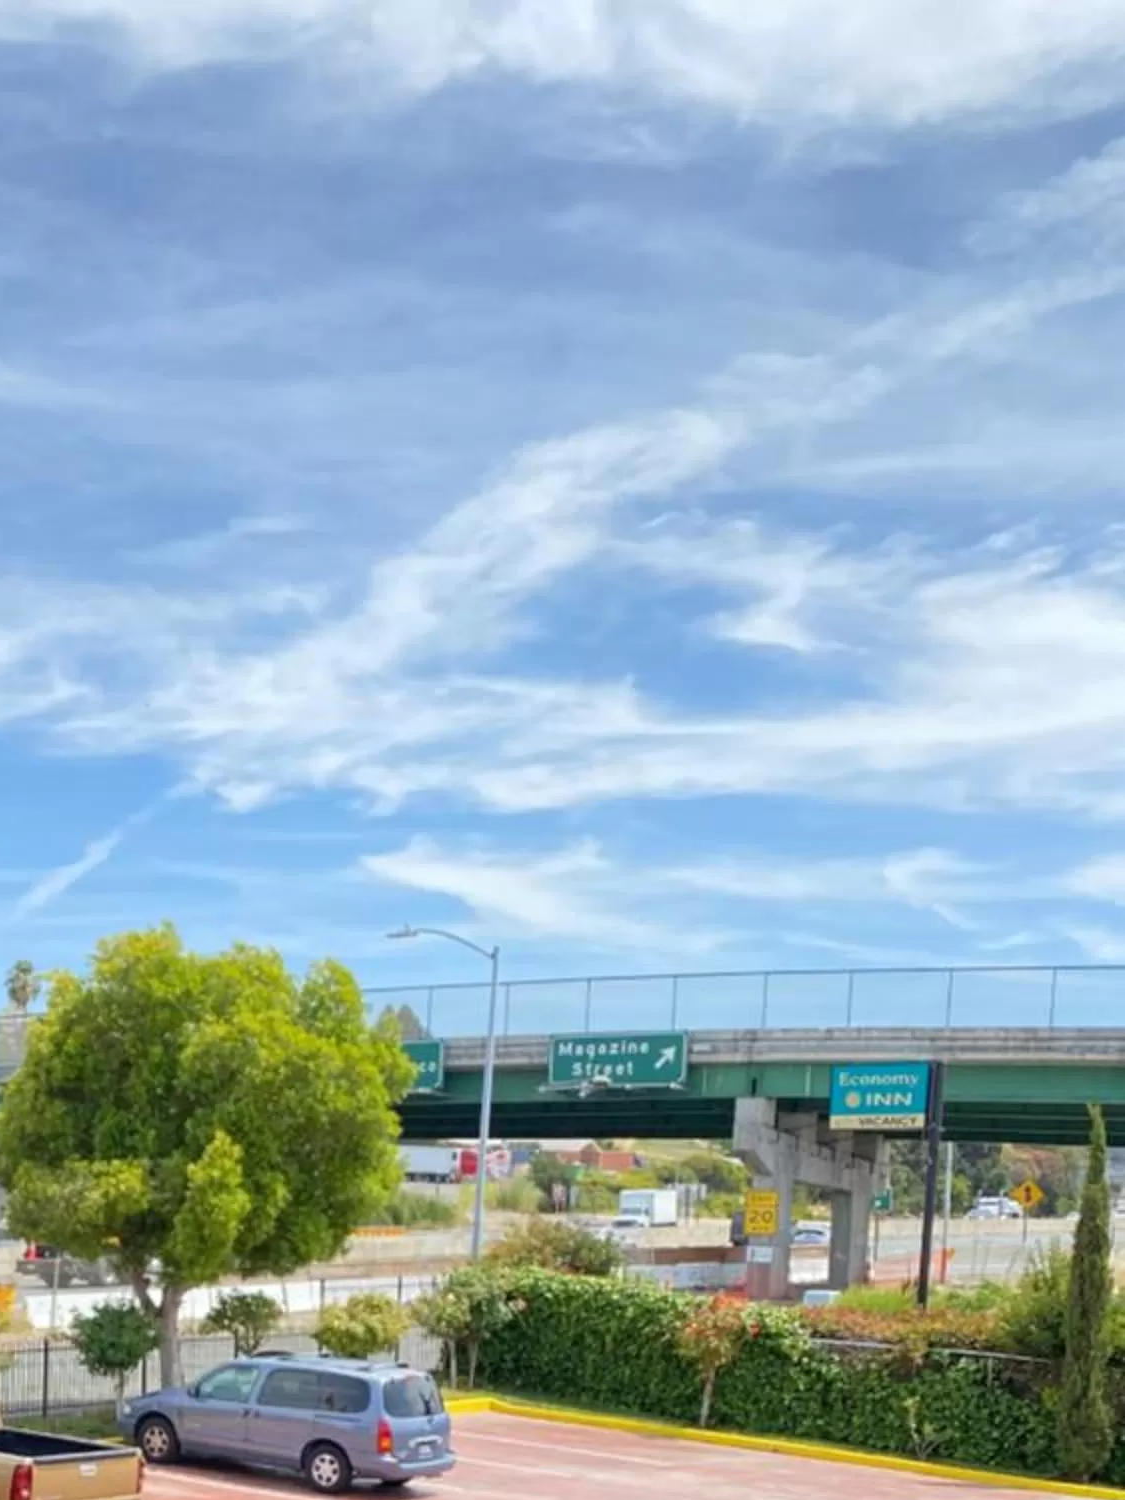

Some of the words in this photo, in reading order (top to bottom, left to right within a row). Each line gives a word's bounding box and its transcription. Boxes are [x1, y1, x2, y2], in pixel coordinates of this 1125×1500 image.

[557, 1040, 651, 1059] Magazine
[571, 1061, 634, 1077] Street
[838, 1071, 918, 1088] Economy
[865, 1091, 913, 1107] INN
[748, 1209, 774, 1225] 20
